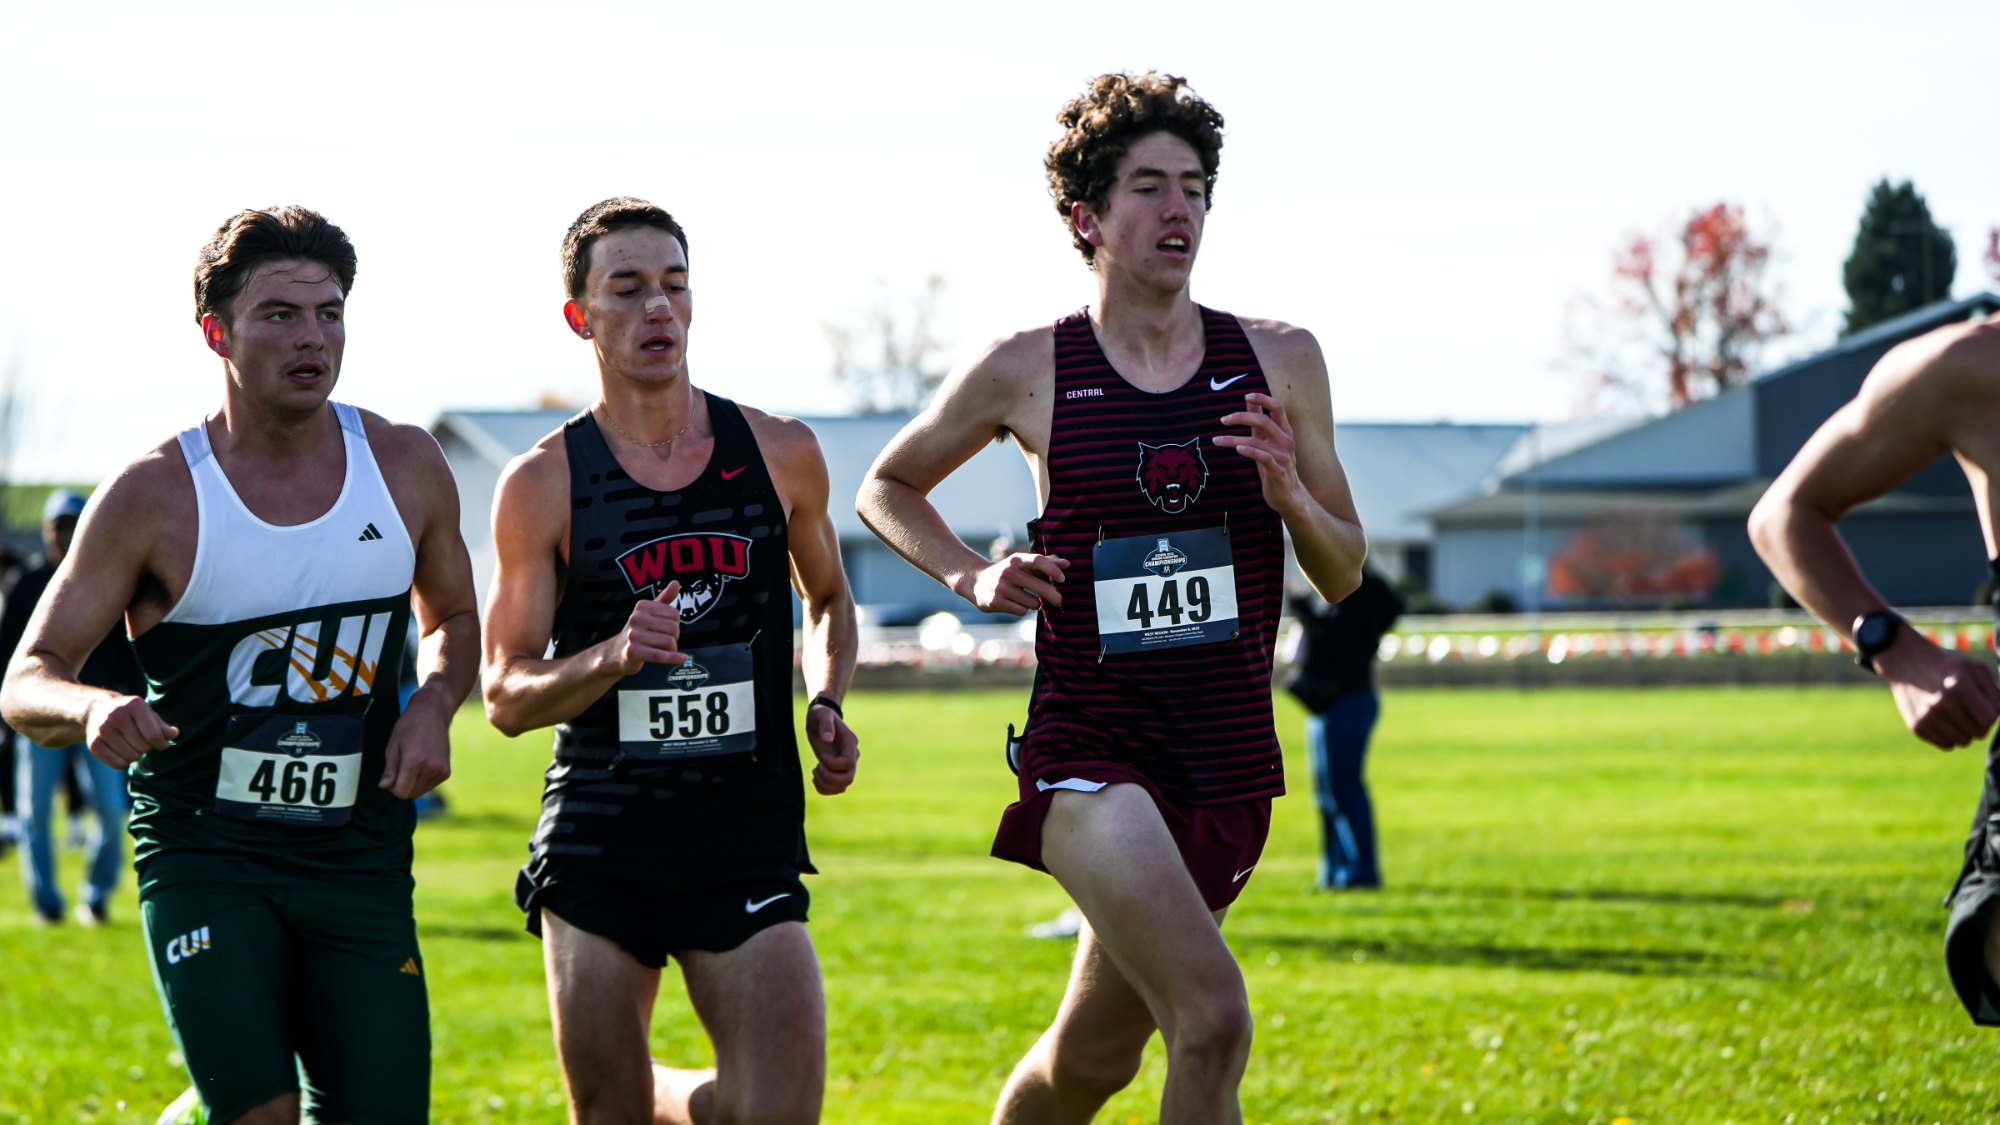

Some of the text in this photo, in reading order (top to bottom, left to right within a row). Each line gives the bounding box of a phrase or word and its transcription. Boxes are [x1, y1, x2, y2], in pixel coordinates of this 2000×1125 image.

[1066, 388, 1104, 399] CENTRAL
[623, 537, 746, 587] WOU
[1145, 557, 1186, 567] CHAMPIONSHIPS
[1127, 576, 1211, 628] 449
[226, 611, 392, 707] CUI
[668, 673, 709, 681] CHAMPIONSHIPS
[649, 691, 730, 740] 558
[248, 759, 337, 806] 466
[166, 925, 211, 964] CUI
